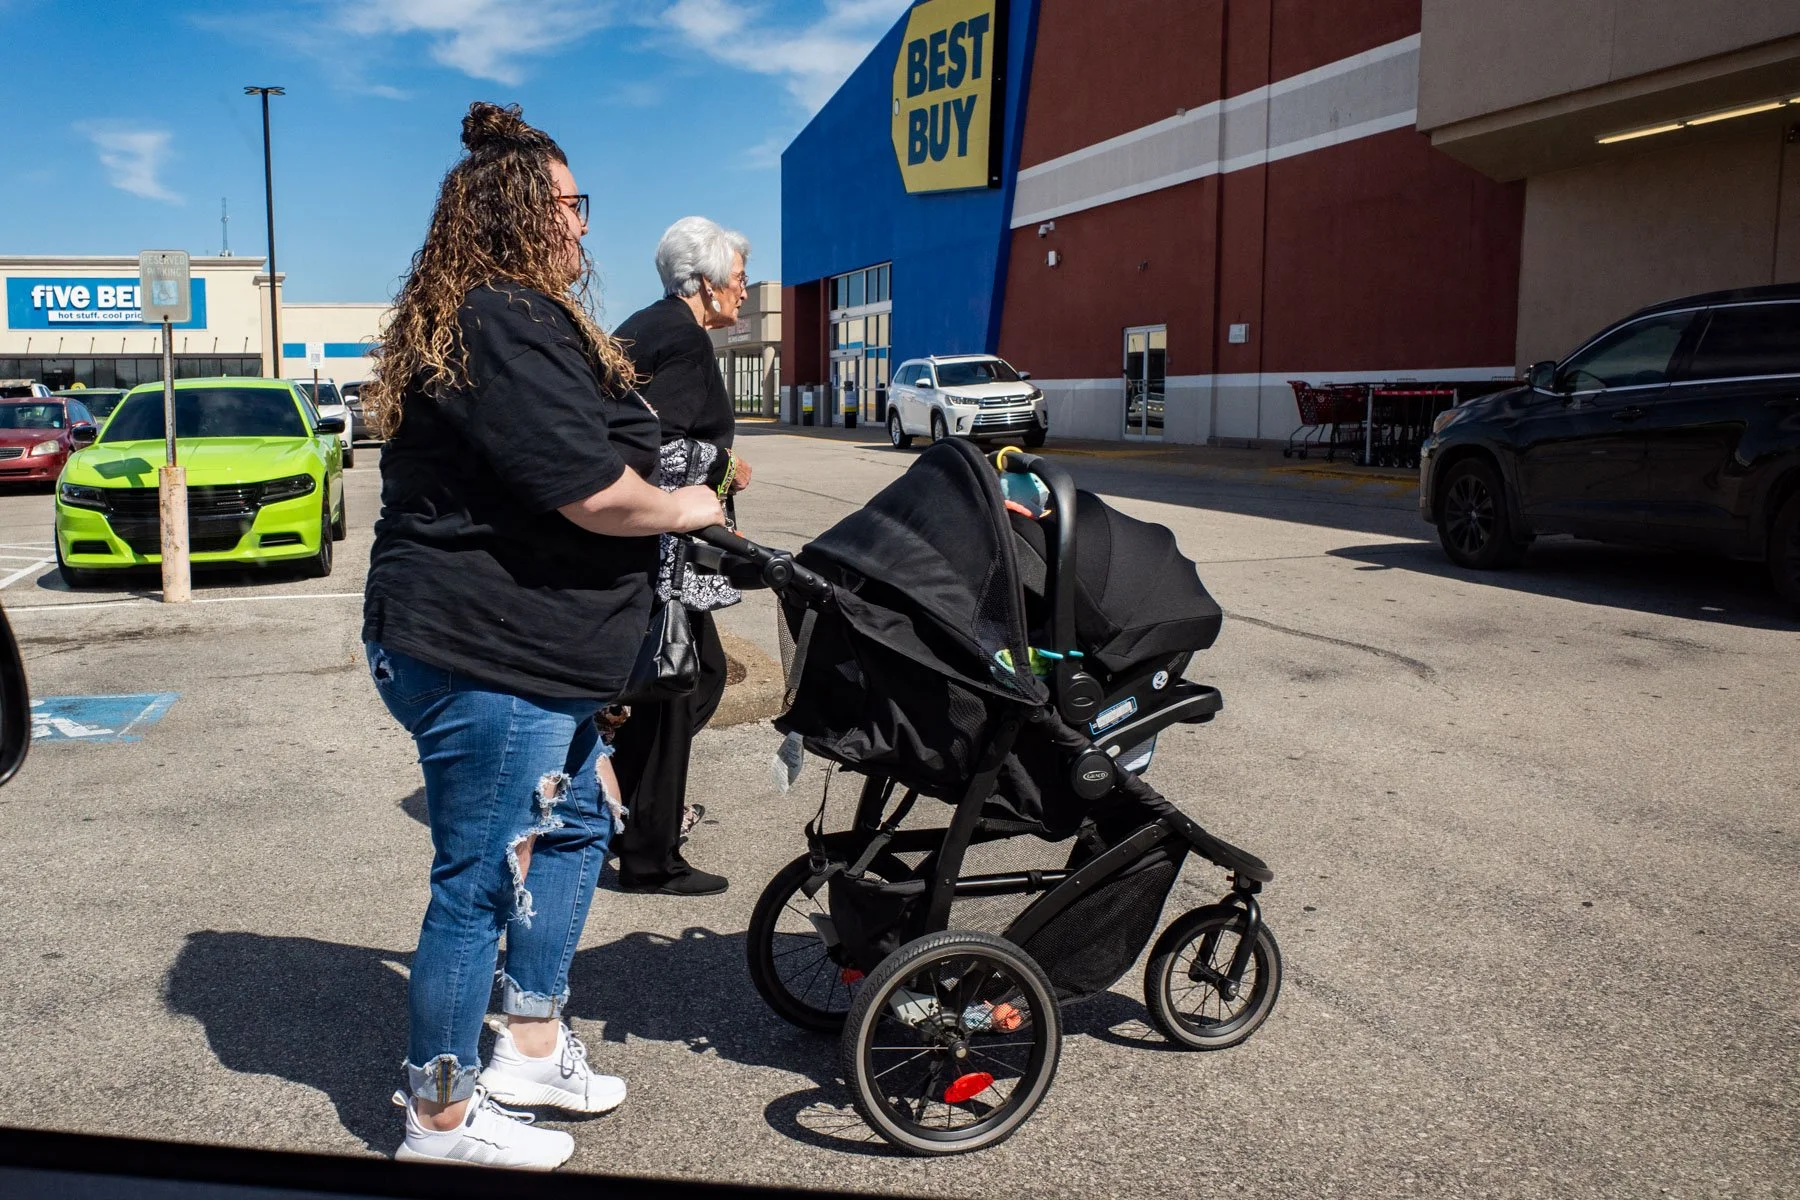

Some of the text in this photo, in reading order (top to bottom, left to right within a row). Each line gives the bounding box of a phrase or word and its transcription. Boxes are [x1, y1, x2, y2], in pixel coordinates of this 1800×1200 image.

[907, 12, 990, 98] BEST
[907, 94, 978, 166] BUY
[142, 255, 185, 265] RESERVED
[31, 285, 91, 309] five
